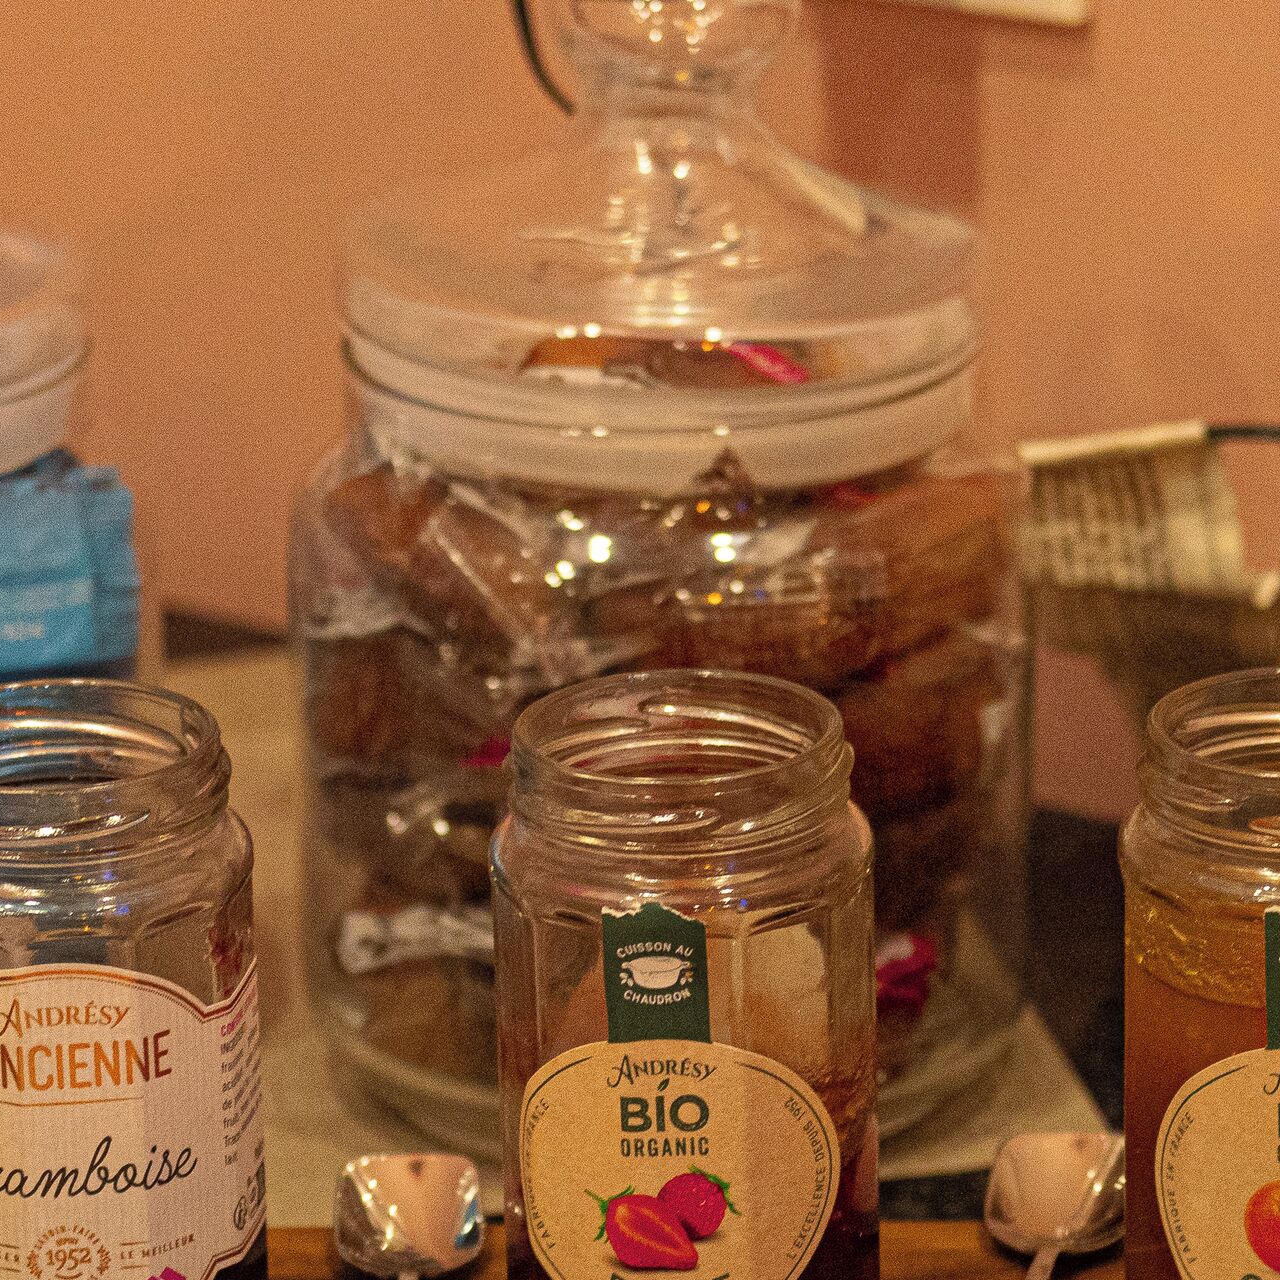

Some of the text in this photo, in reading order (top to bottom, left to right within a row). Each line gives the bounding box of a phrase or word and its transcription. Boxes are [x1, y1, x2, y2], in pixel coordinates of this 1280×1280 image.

[616, 941, 694, 958] CUISSON AU
[623, 989, 692, 1006] CHAUDRON
[620, 1137, 710, 1158] ORGANIC
[120, 1233, 196, 1262] LE MEILLEUR
[45, 1247, 92, 1272] 1952
